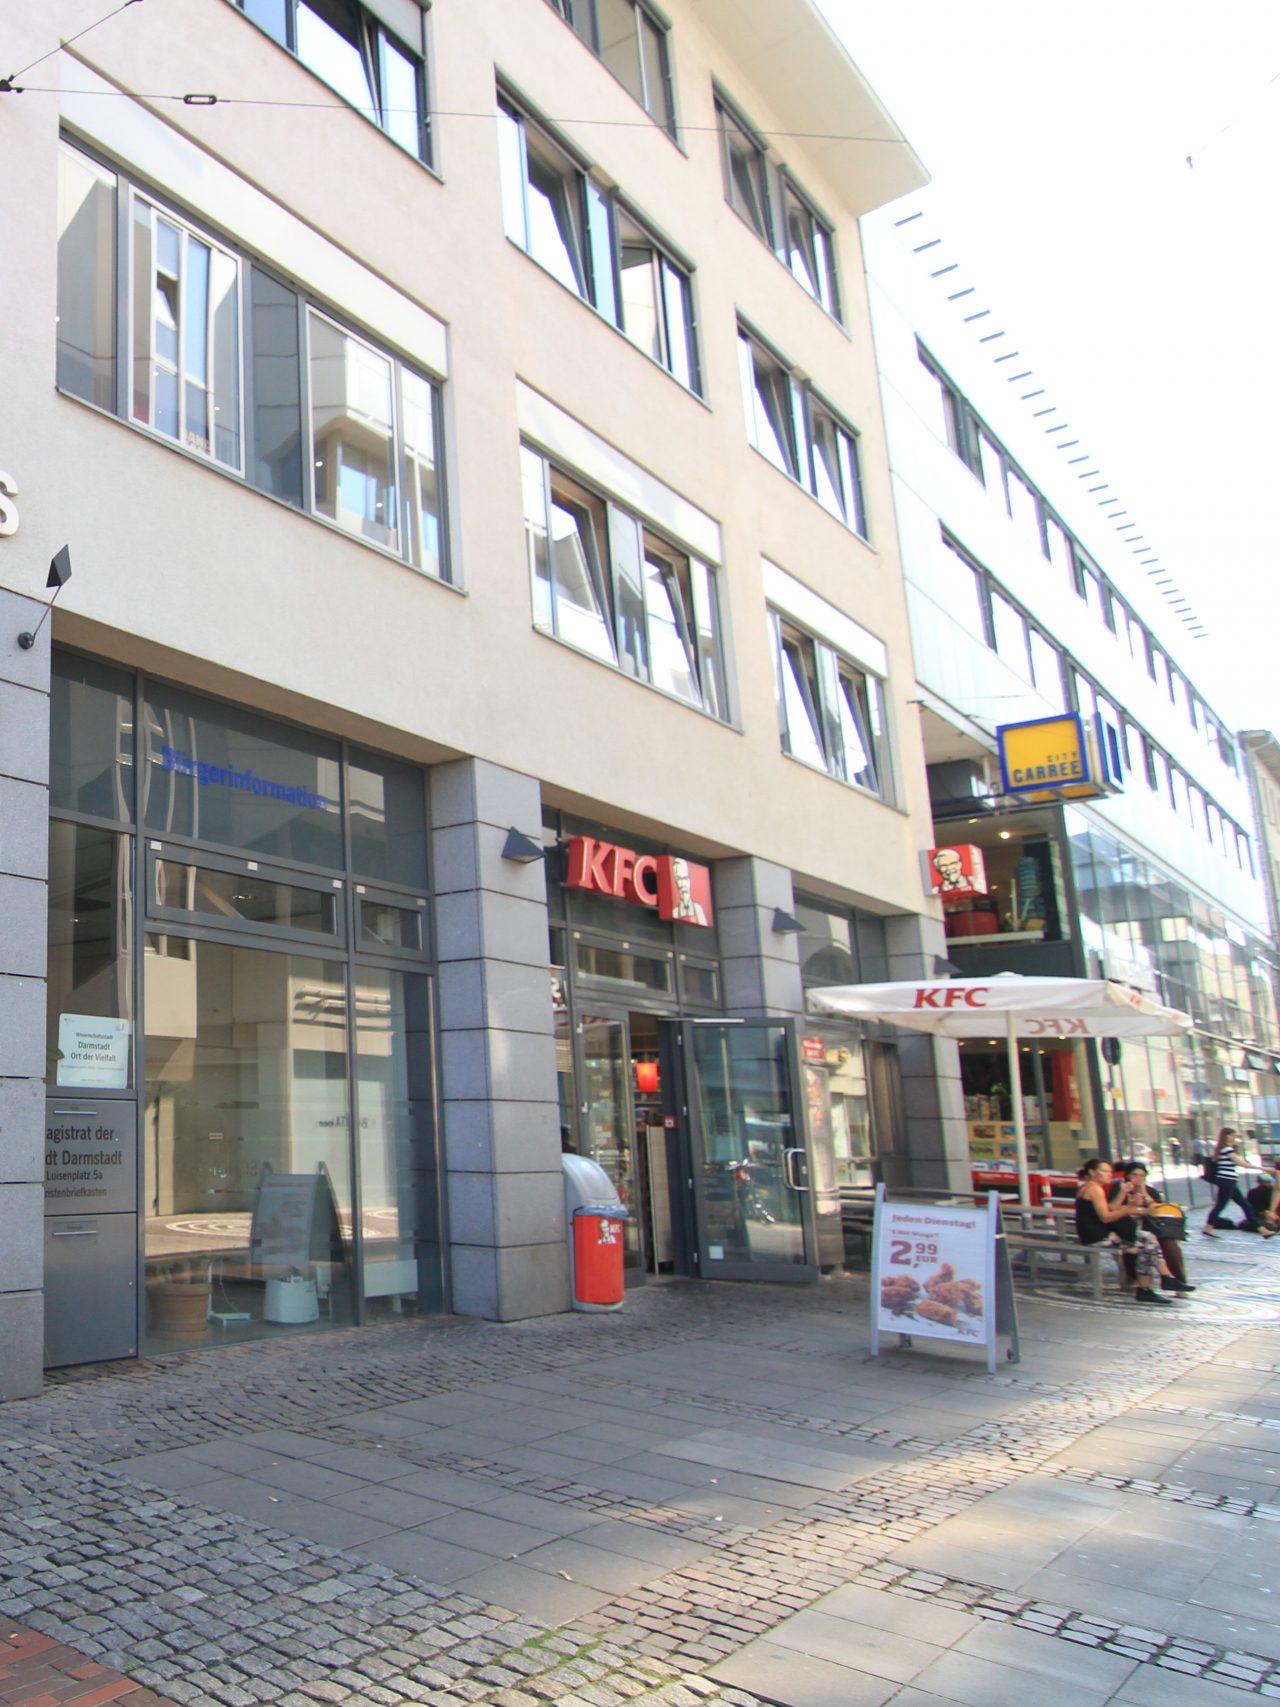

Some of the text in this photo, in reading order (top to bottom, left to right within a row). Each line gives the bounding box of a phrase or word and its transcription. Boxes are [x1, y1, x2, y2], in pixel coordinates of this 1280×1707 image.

[1047, 750, 1079, 763] CITY
[162, 745, 329, 811] Bürgerinformation
[1012, 760, 1081, 783] CARREE
[578, 835, 658, 906] KFC
[912, 986, 992, 1010] KFC
[78, 1041, 111, 1051] Darmstadt
[70, 1051, 117, 1063] Ort der Vielfalt
[95, 1125, 115, 1141] der
[45, 1150, 123, 1166] dt Darmstadt
[46, 1168, 104, 1182] Luisenplatz 5a
